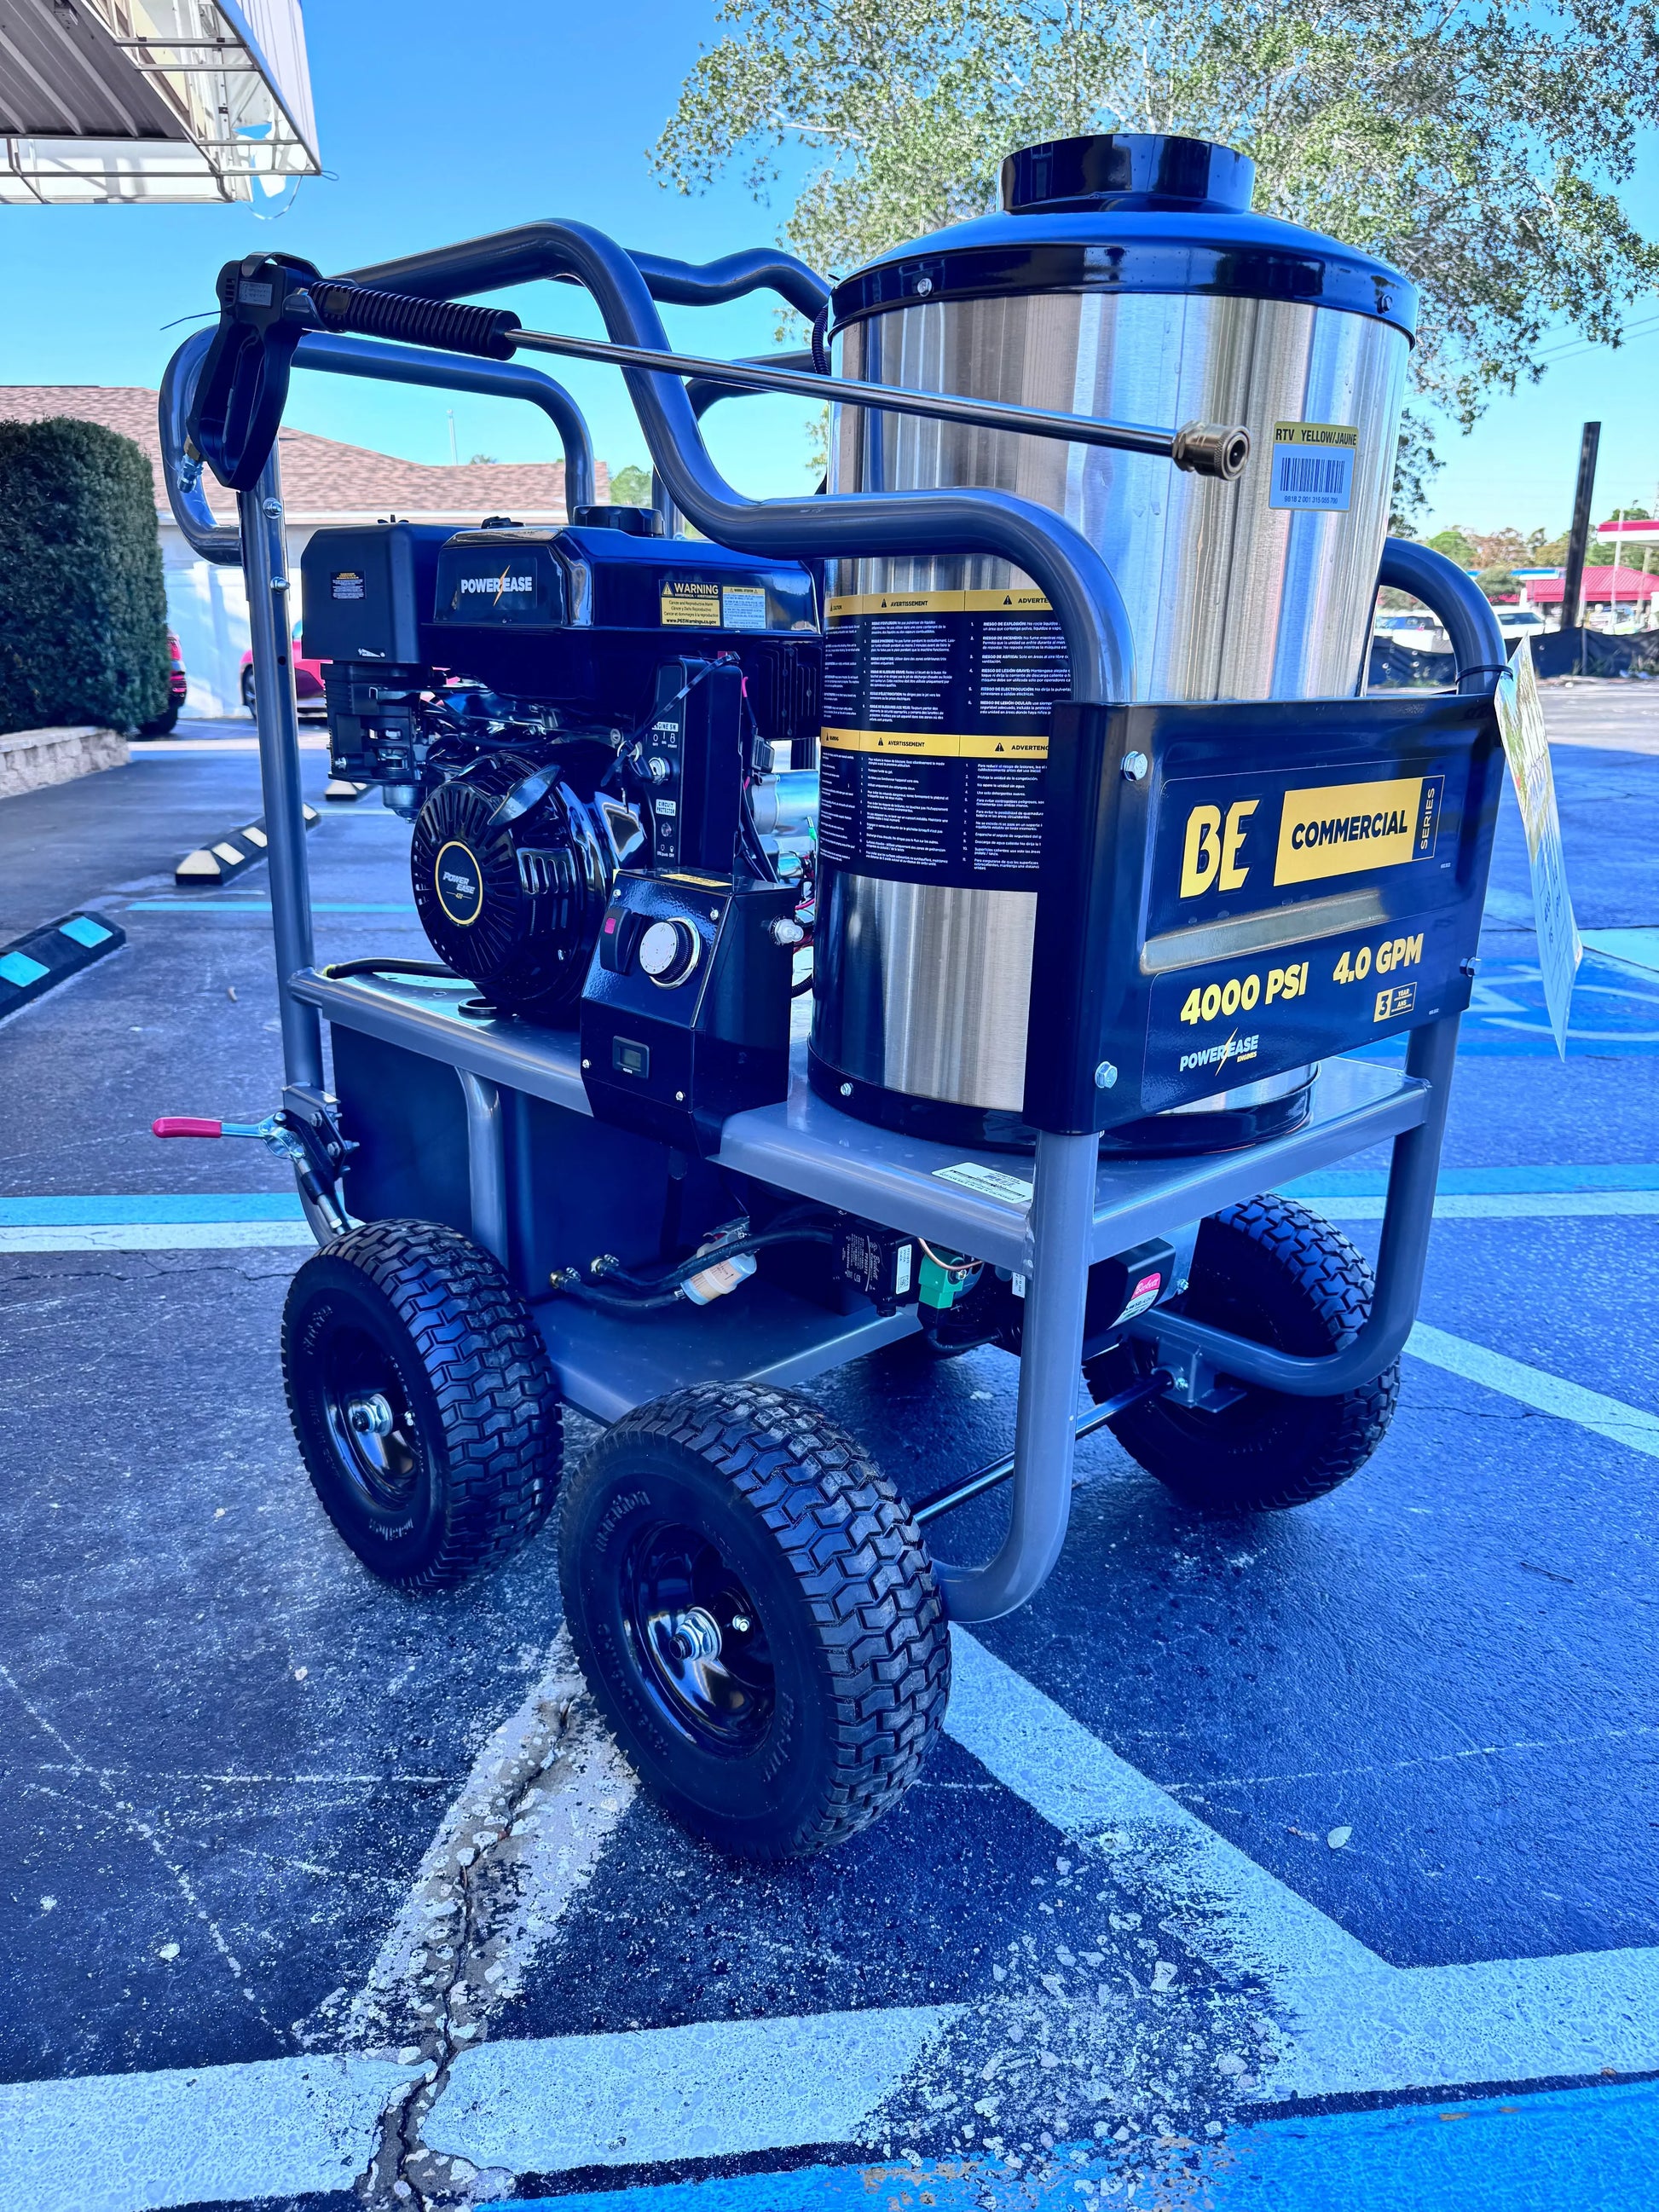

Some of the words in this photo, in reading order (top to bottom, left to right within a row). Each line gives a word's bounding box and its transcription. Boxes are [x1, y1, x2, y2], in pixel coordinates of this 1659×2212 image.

[1275, 429, 1294, 441] RTV
[1301, 430, 1357, 446] YELLOW/JAUNE
[460, 576, 532, 594] POWEREASE
[674, 582, 719, 594] WARNING
[1291, 810, 1408, 850] COMMERCIAL
[1420, 788, 1436, 850] SERIES
[1180, 799, 1260, 898] BE
[442, 871, 470, 885] POWER
[456, 883, 476, 894] EASE
[1180, 974, 1261, 1025] 4000
[1265, 962, 1309, 1005] PSI
[1332, 946, 1372, 985] 4.0
[1376, 933, 1424, 974] GPM
[1398, 989, 1409, 997] YEAR
[1379, 994, 1389, 1016] 3
[1179, 1034, 1259, 1071] POWEREASE
[1237, 1051, 1257, 1063] ENGINES
